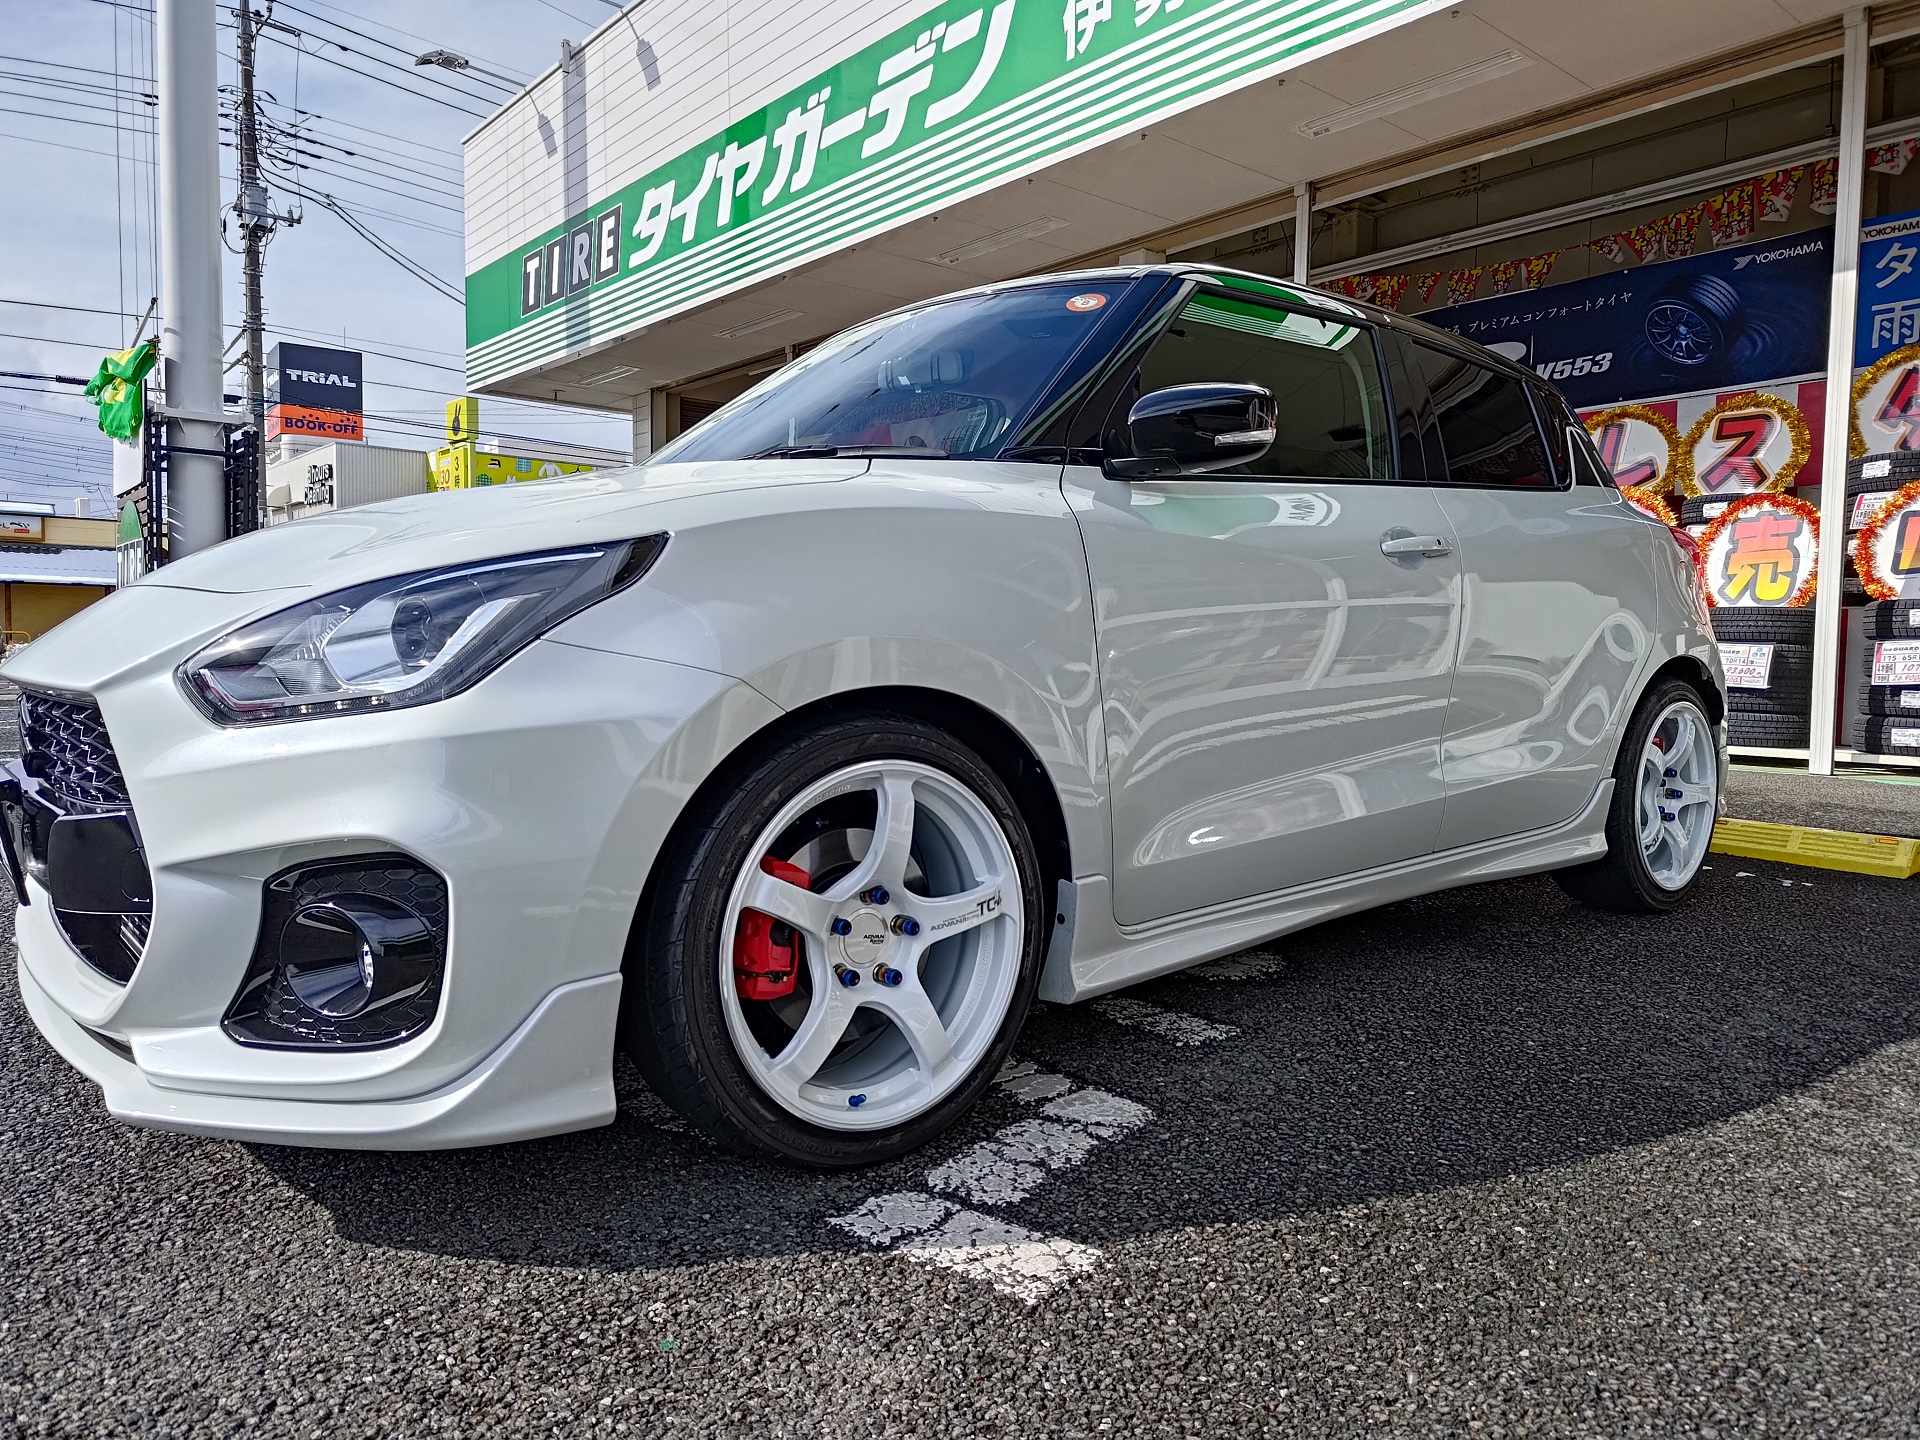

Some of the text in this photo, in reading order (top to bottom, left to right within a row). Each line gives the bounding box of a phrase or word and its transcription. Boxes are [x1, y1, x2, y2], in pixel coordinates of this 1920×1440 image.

[525, 0, 1016, 308] TIRE タイヤガーデン
[1863, 220, 1920, 239] YOKOHAM
[1755, 241, 1824, 264] YOKOHAMA
[1469, 291, 1633, 333] プレミアムコンフォートタイヤ
[1871, 298, 1920, 349] 雨
[1720, 511, 1802, 604] 売
[929, 917, 963, 932] ADVAN
